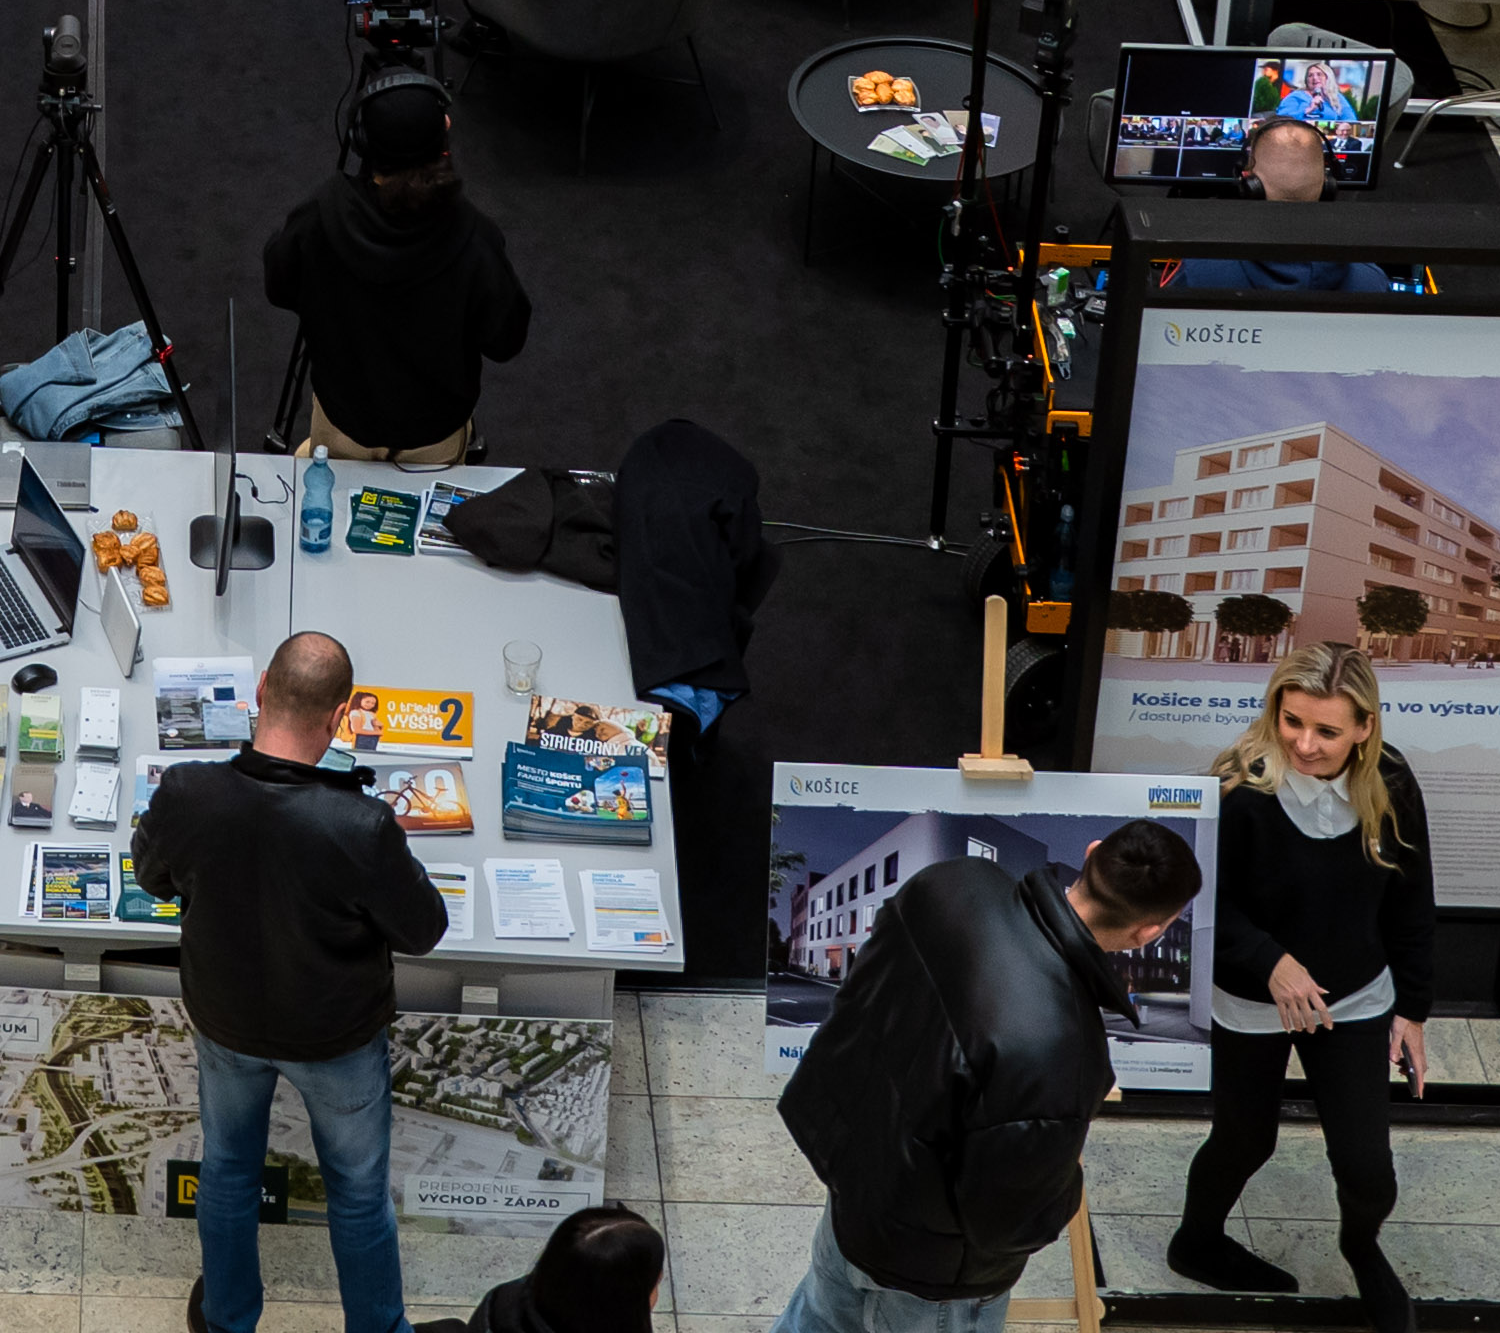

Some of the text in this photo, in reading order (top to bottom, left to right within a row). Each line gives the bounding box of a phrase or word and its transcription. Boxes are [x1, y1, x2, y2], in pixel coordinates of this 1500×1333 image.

[1184, 324, 1263, 345] KOŠICE
[1132, 691, 1202, 709] Košice
[1208, 695, 1232, 709] sa
[1398, 701, 1424, 713] vo
[440, 698, 464, 741] 2
[517, 763, 582, 781] MESTO KOŠICE
[517, 770, 582, 789] FANDÍ ŠPORTU
[804, 777, 859, 795] KOŠICE
[418, 1178, 521, 1197] PREPOJENIE
[417, 1188, 488, 1207] VÝCHOD
[504, 1192, 561, 1211] ZÁPAD
